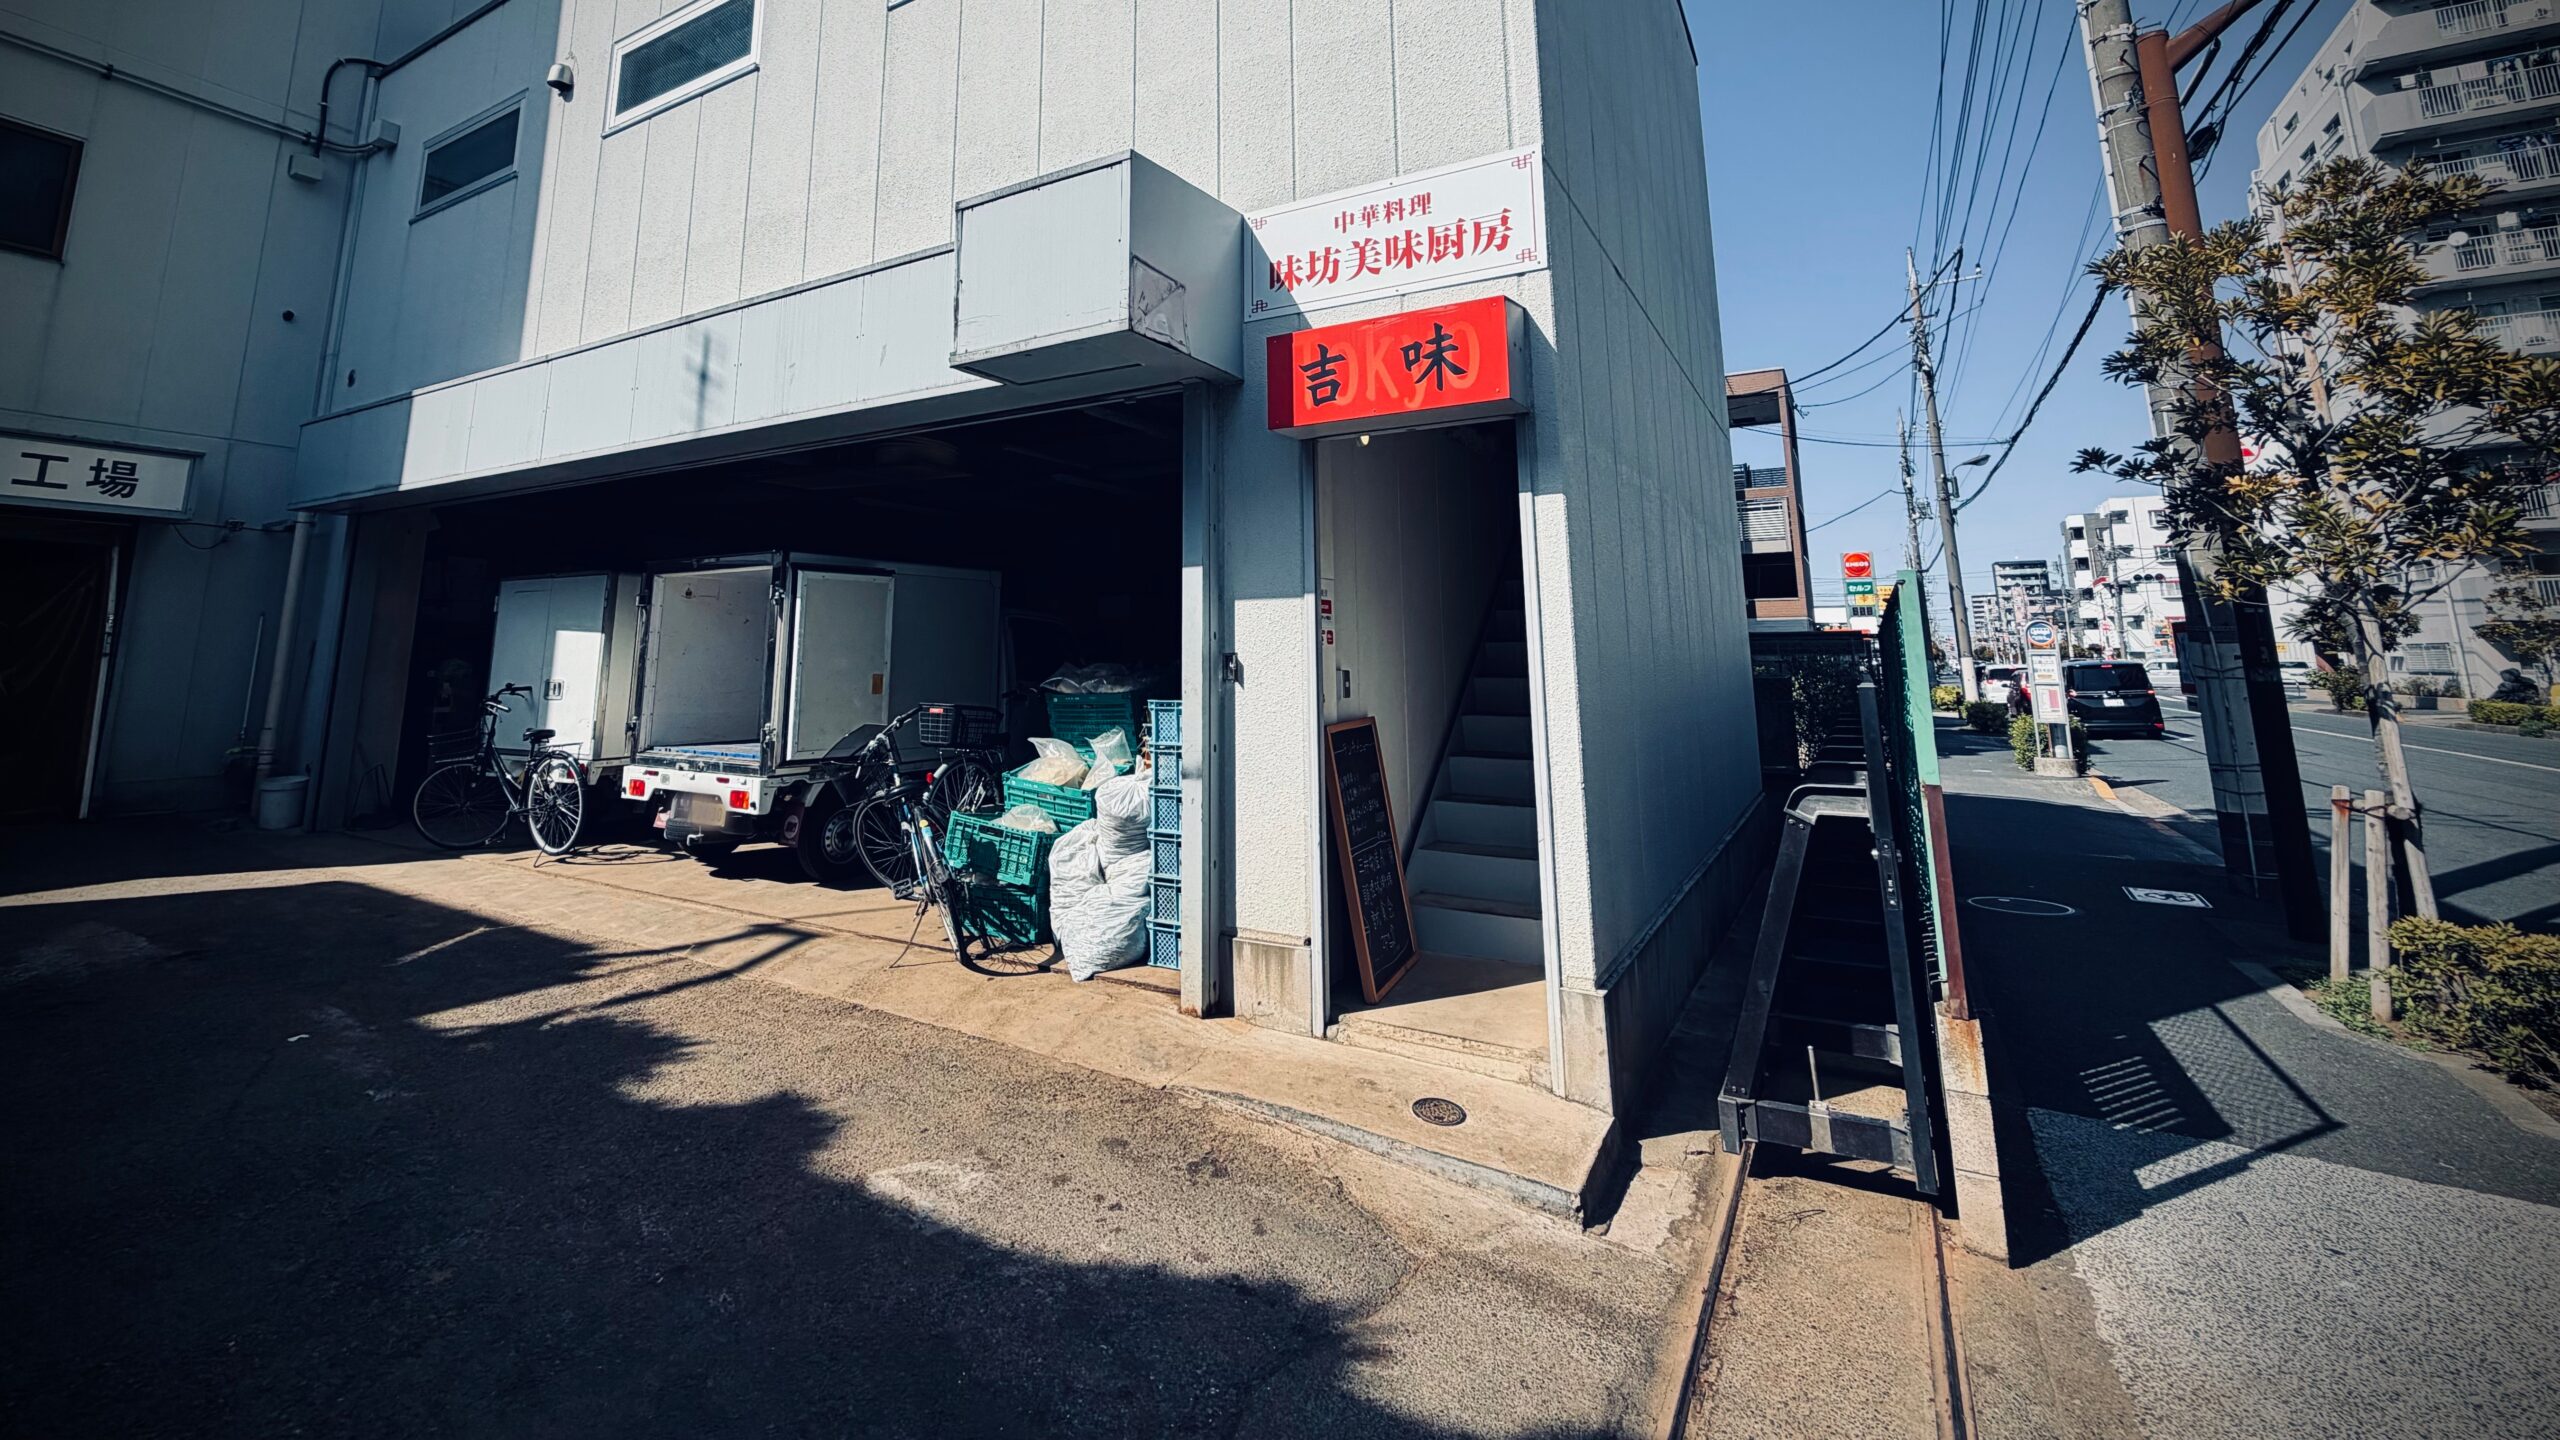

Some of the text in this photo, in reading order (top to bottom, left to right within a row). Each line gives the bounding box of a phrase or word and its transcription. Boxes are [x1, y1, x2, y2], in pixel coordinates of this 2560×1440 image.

[1333, 191, 1433, 235] 中華料理
[1268, 207, 1514, 294] 味坊美味厨房
[1298, 322, 1468, 407] 吉味
[11, 452, 139, 499] 工場
[1848, 585, 1872, 593] セルフ
